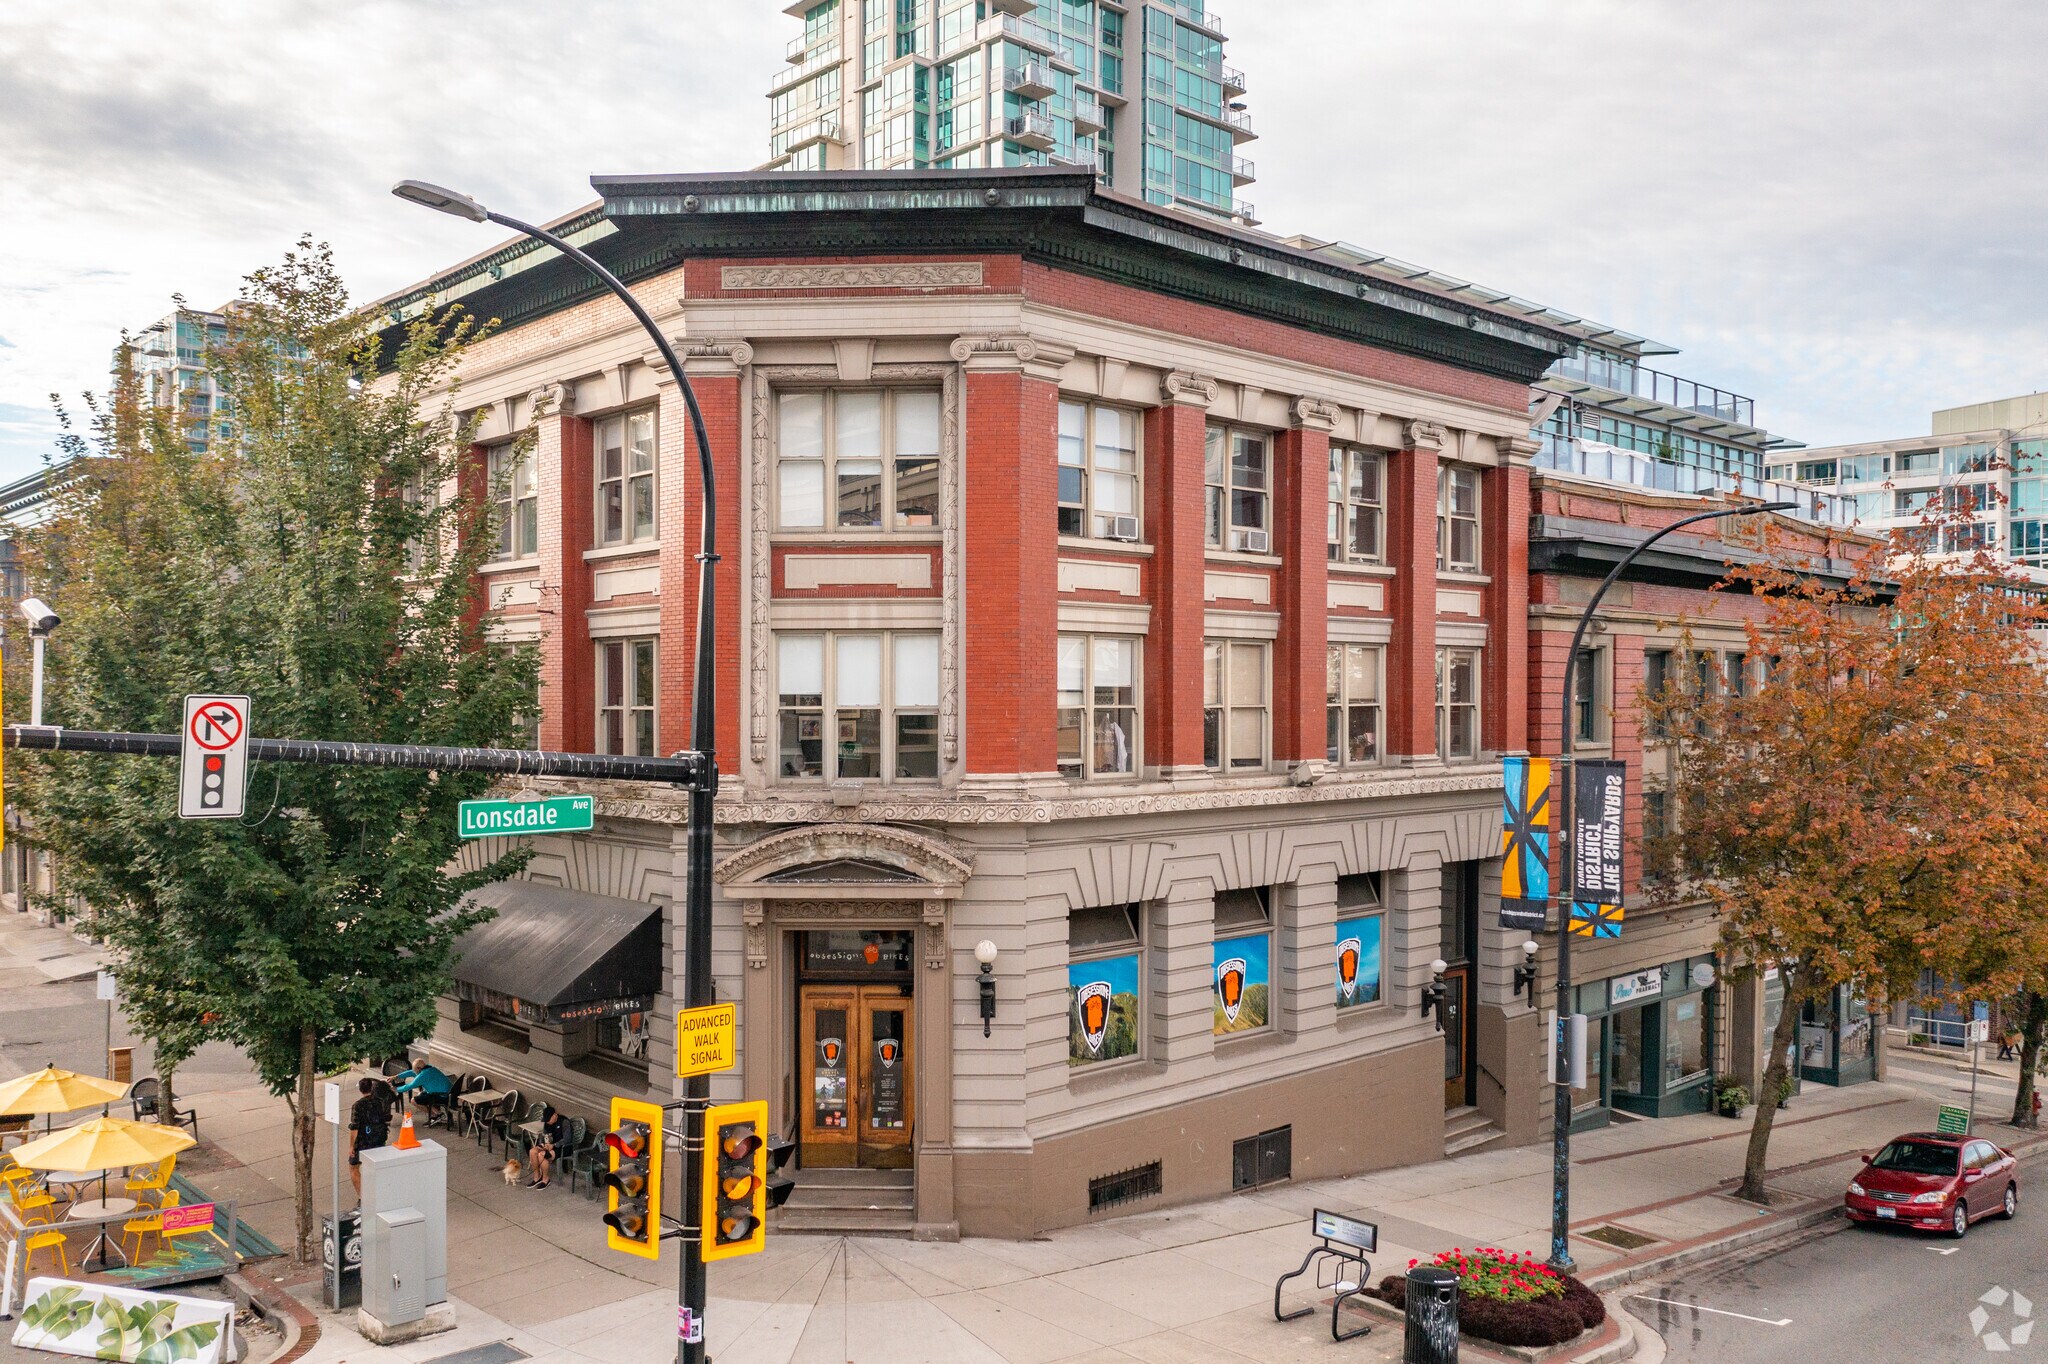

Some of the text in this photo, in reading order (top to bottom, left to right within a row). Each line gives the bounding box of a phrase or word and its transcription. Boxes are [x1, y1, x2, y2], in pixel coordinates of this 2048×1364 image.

[466, 800, 589, 829] Lonsdale Ave
[1636, 982, 1661, 994] PHARMACY
[615, 1000, 640, 1011] BIKES
[1448, 1005, 1456, 1015] 92
[683, 1013, 731, 1032] ADVANCED
[694, 1032, 719, 1047] WALK
[691, 1049, 723, 1066] SIGNAL
